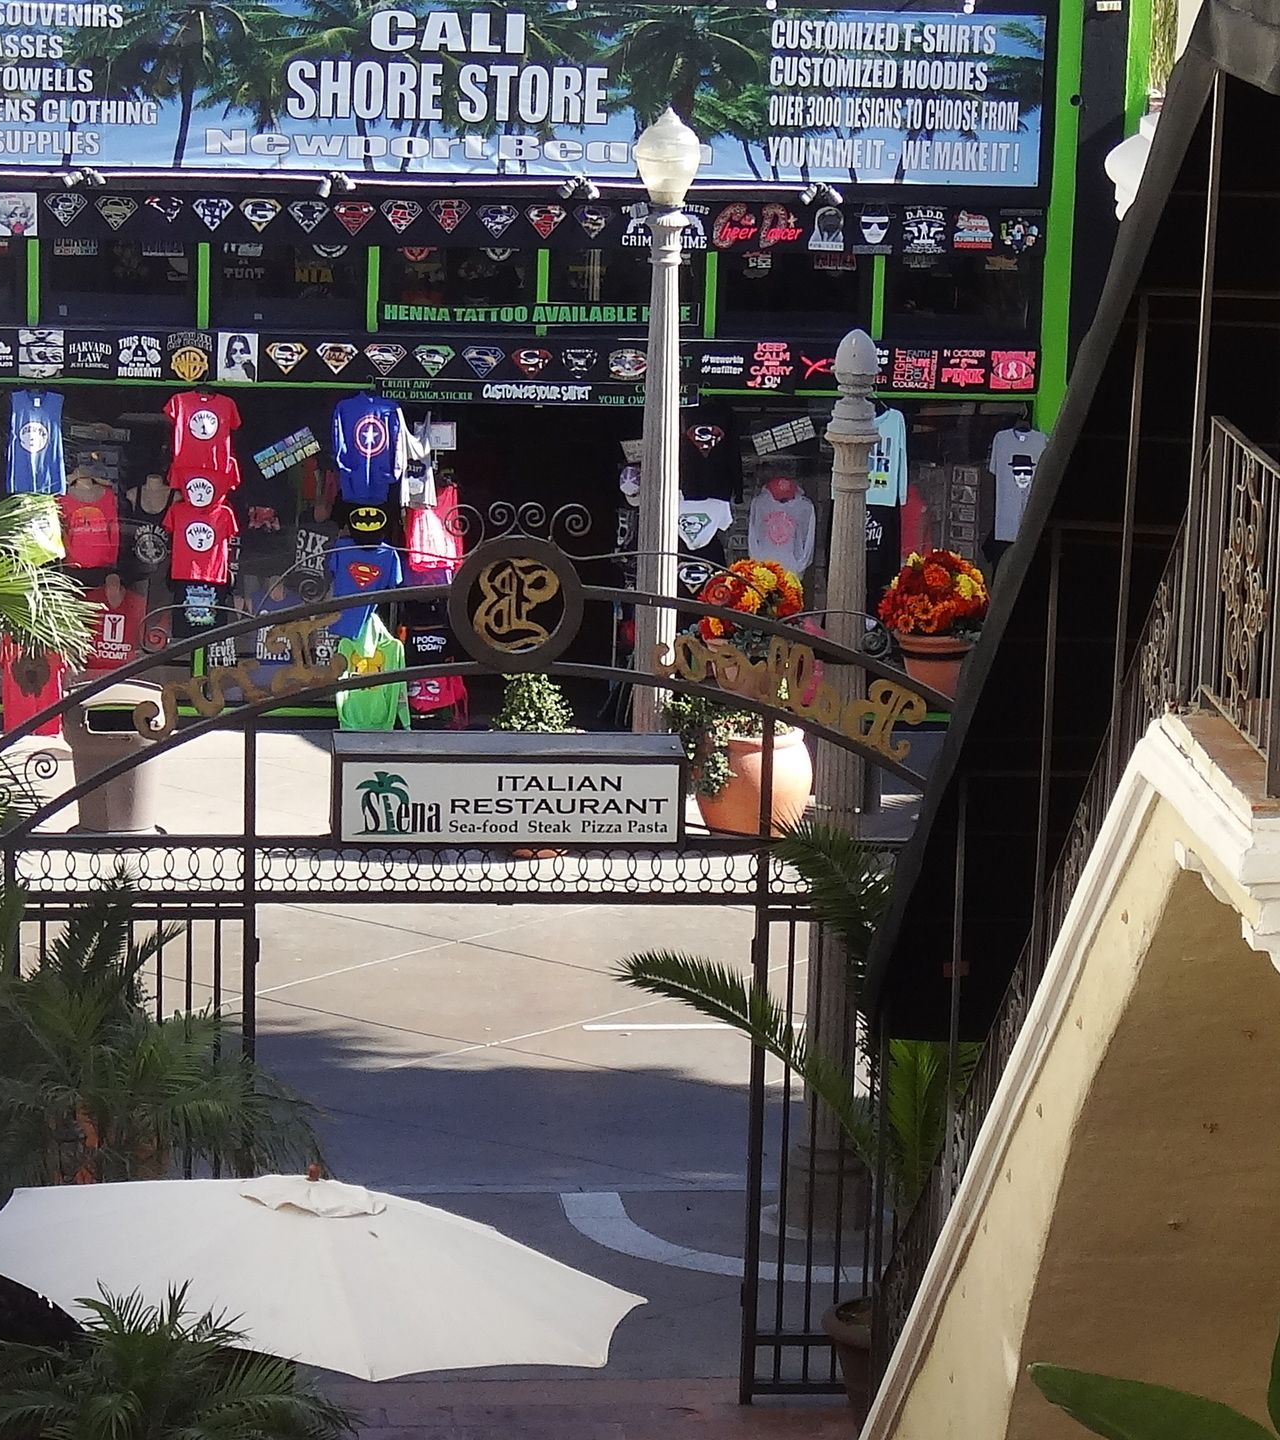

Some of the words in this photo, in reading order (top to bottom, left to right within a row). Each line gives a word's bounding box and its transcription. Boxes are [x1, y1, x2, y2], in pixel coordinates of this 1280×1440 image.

[371, 10, 526, 54] CALI
[771, 20, 899, 51] CUSTOMIZED
[902, 23, 996, 54] T-SHIRTS
[770, 57, 897, 89] CUSTOMIZED
[902, 60, 988, 92] HOODIES
[287, 60, 443, 121] SHORE
[458, 64, 609, 125] STORE
[42, 100, 158, 125] CLOTHING
[769, 94, 804, 127] OVER
[806, 95, 842, 128] 3000
[845, 97, 902, 129] DESIGNS
[904, 98, 923, 130] TO
[925, 99, 978, 131] CHOOSE
[981, 101, 1019, 132] FROM
[205, 128, 488, 161] Newport
[499, 134, 638, 164] Bea
[768, 136, 806, 168] YOU
[809, 138, 862, 169] NAME
[865, 139, 885, 170] IT
[902, 140, 932, 171] WE
[933, 141, 989, 172] MAKE
[991, 142, 1010, 172] IT
[621, 235, 653, 246] CRIM
[384, 304, 450, 321] HENNA
[453, 305, 528, 323] TATTOO
[532, 306, 637, 323] AVAILABLE
[642, 307, 691, 322] HE
[69, 341, 112, 356] HARVARD
[118, 336, 140, 350] THIS
[141, 336, 162, 351] GIRL
[757, 343, 787, 352] KEEP
[77, 352, 103, 363] LAW
[753, 352, 791, 361] CALM
[952, 349, 986, 358] OCTOBER
[750, 366, 793, 375] CARRY
[893, 348, 907, 380] FIGHT
[117, 367, 162, 378] MOMMY!
[941, 368, 985, 384] PINK
[892, 381, 929, 389] COURAGE
[628, 395, 646, 404] OW
[192, 413, 216, 426] THING
[200, 424, 207, 435] 1
[188, 482, 212, 495] THING
[196, 493, 204, 502] 2
[187, 526, 213, 540] THING
[296, 529, 329, 555] SIX
[97, 641, 132, 652] POOPED
[497, 775, 623, 792] ITALIAN
[450, 798, 669, 815] RESTAURANT
[448, 820, 519, 834] Sea-food
[528, 820, 572, 834] Steak
[581, 820, 622, 834] Pizza
[628, 821, 668, 834] Pasta
